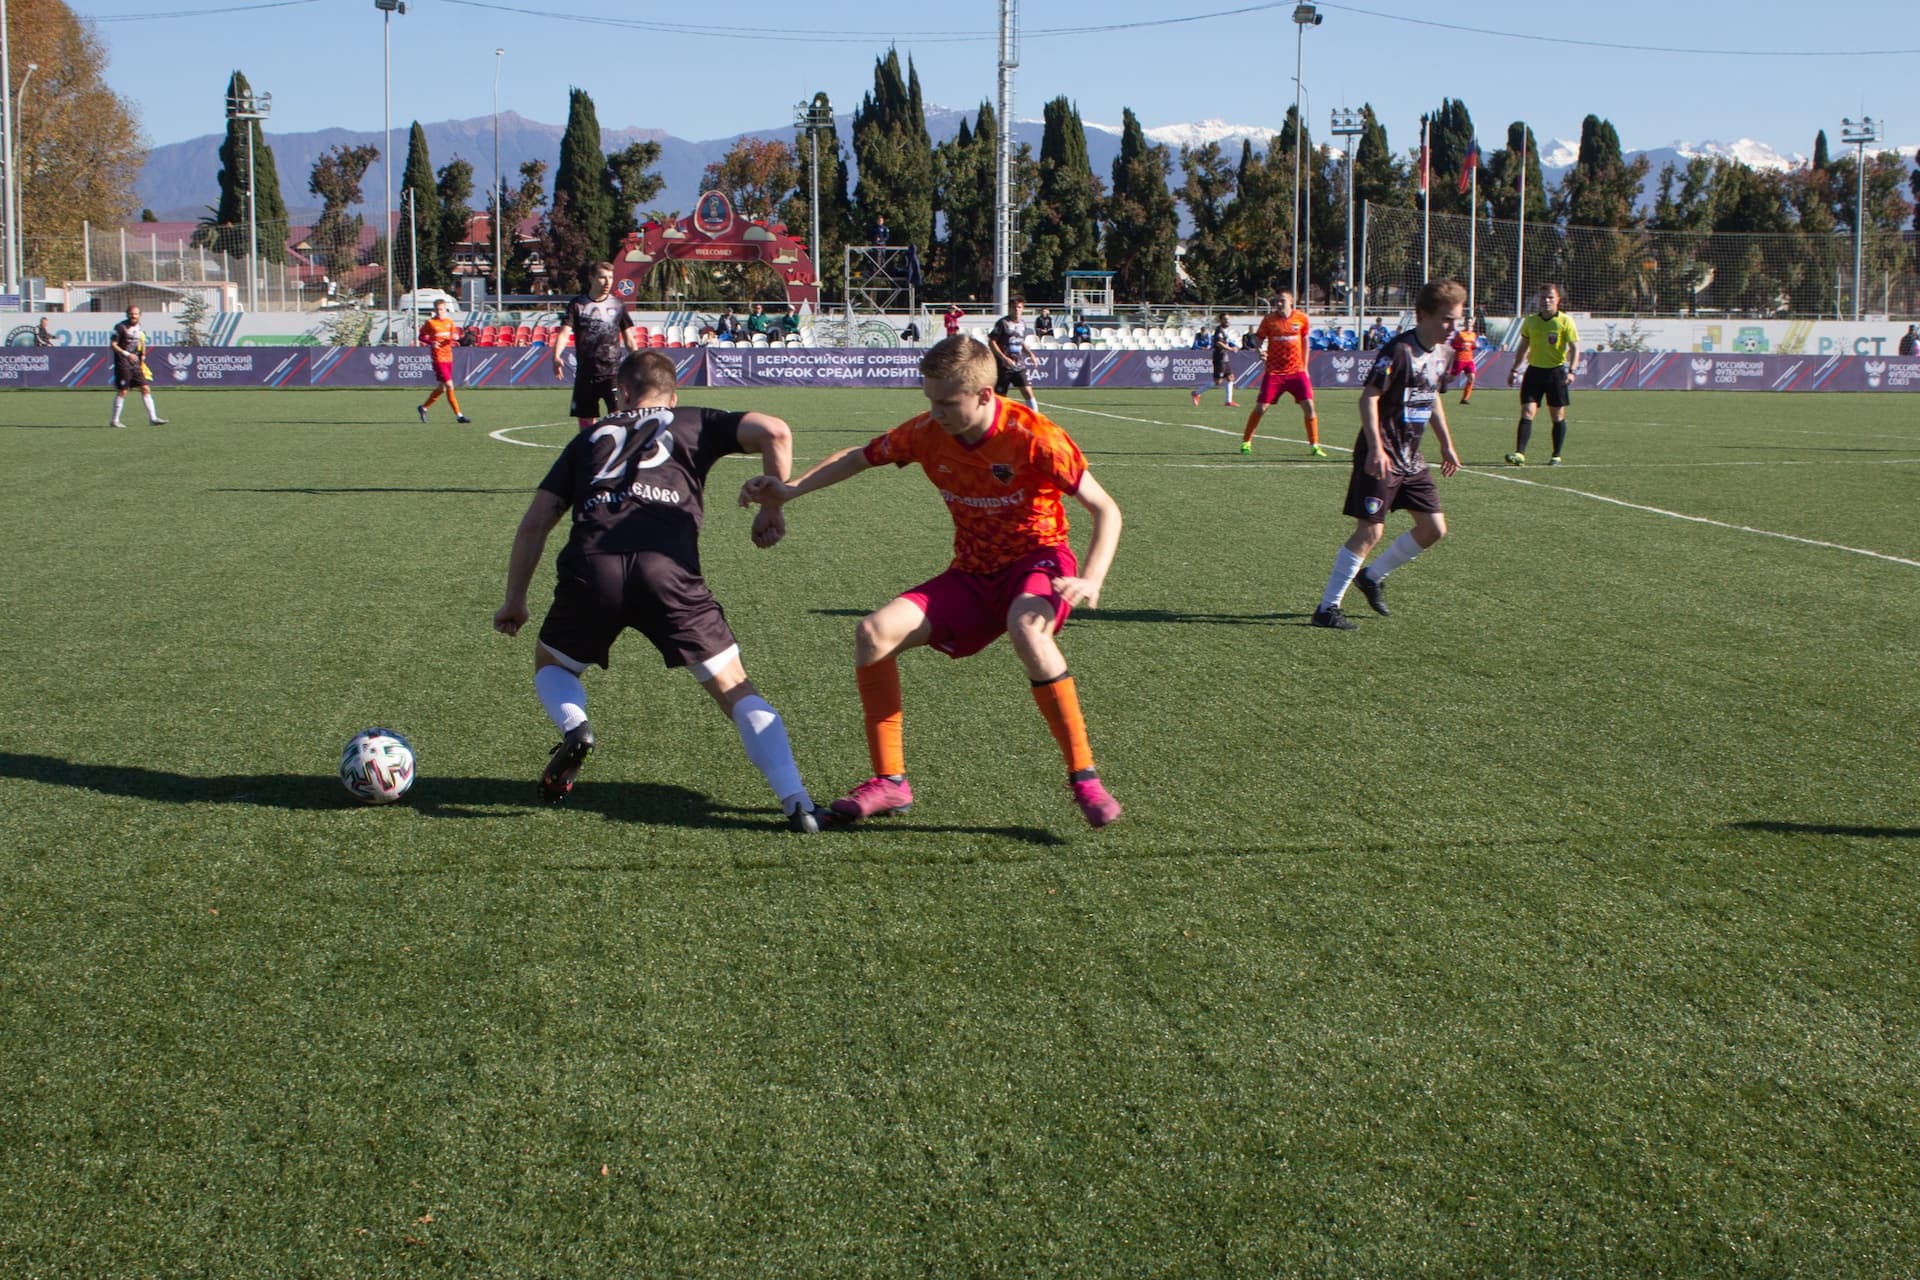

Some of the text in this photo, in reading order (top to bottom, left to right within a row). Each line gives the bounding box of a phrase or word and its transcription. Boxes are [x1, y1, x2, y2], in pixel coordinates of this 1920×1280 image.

[0, 354, 49, 363] ОССИЙСКИЙ
[197, 354, 253, 363] РОССИЙСКИЙ
[398, 354, 433, 363] РОССИЙ
[716, 355, 742, 363] СОЧИ
[757, 353, 865, 365] ВСЕРОССИЙСКИЕ
[0, 363, 49, 371] УТБОЛЬНЫЙ
[197, 363, 253, 372] ФУТБОЛЬНЫЙ
[1715, 360, 1764, 369] РОССИЙСКИЙ
[0, 371, 18, 379] ОЮЗ
[197, 371, 223, 379] СОЮЗ
[398, 371, 423, 379] СОЮЗ
[716, 368, 743, 378] 2021
[758, 367, 814, 378] «КУБОК
[817, 367, 863, 380] СРЕДИ
[1173, 373, 1196, 381] СОЮЗ
[1715, 368, 1764, 377] ФУТБОЛЬНЫЙ
[1715, 376, 1737, 384] СОЮЗ
[1888, 378, 1910, 386] СОЮЗ
[588, 406, 675, 486] 23
